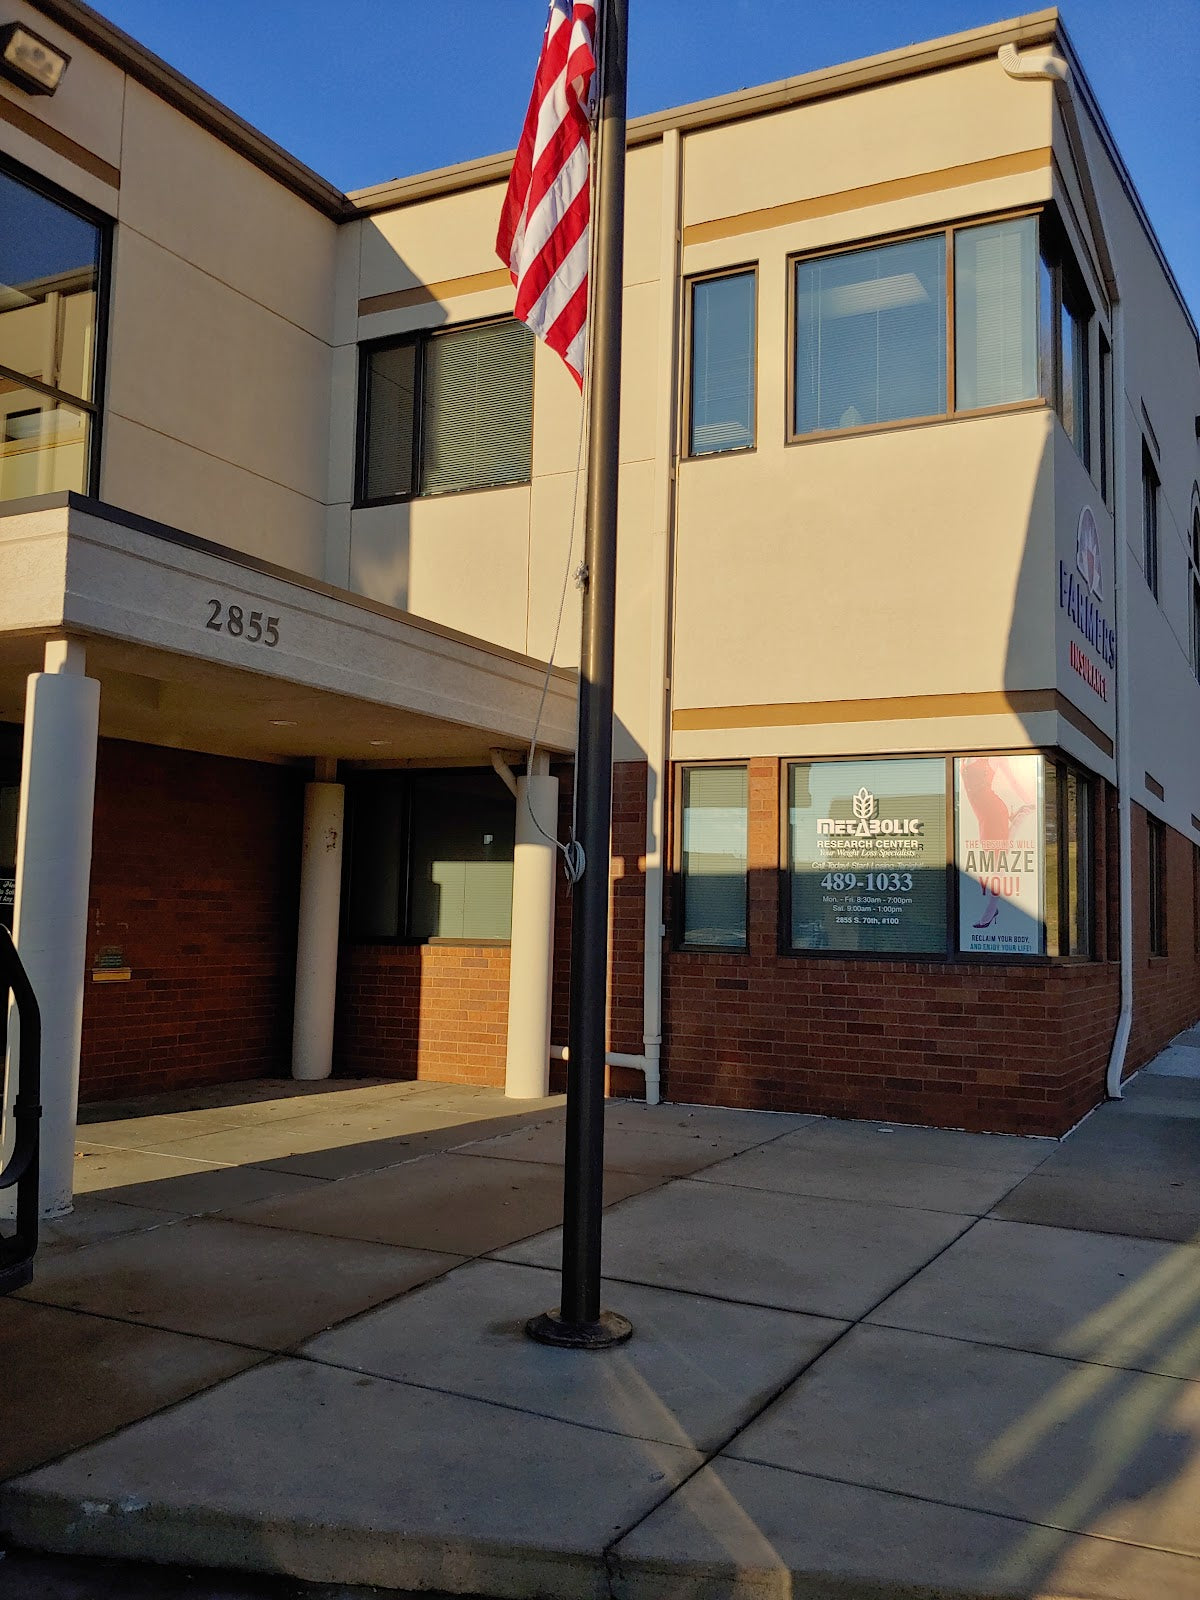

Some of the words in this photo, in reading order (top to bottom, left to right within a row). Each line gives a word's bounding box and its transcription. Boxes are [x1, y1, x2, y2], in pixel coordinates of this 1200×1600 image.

[1060, 560, 1114, 669] FARMERS
[206, 599, 280, 647] 2855
[1070, 640, 1108, 702] INSURANCE
[816, 818, 919, 836] METABOLIC
[816, 840, 872, 848] RESEARCH
[875, 840, 918, 848] CENTER
[965, 840, 979, 849] THE
[1016, 840, 1035, 849] WILL
[820, 849, 836, 857] Your
[837, 849, 859, 857] Weight
[861, 849, 877, 857] Loss
[879, 849, 915, 857] Specialists
[811, 861, 827, 869] Call
[851, 861, 869, 869] Start
[965, 850, 1035, 873] AMAZE
[821, 873, 913, 891] 489-1033
[978, 876, 1020, 897] YOU!
[856, 896, 882, 904] 8:30am
[887, 897, 913, 905] 7:00pm
[881, 917, 900, 925] #100
[971, 934, 996, 942] RECLAIM
[1013, 936, 1030, 944] BODY,
[969, 943, 982, 951] AND
[1000, 944, 1017, 952] YOUR
[1017, 944, 1032, 952] LIFE!
